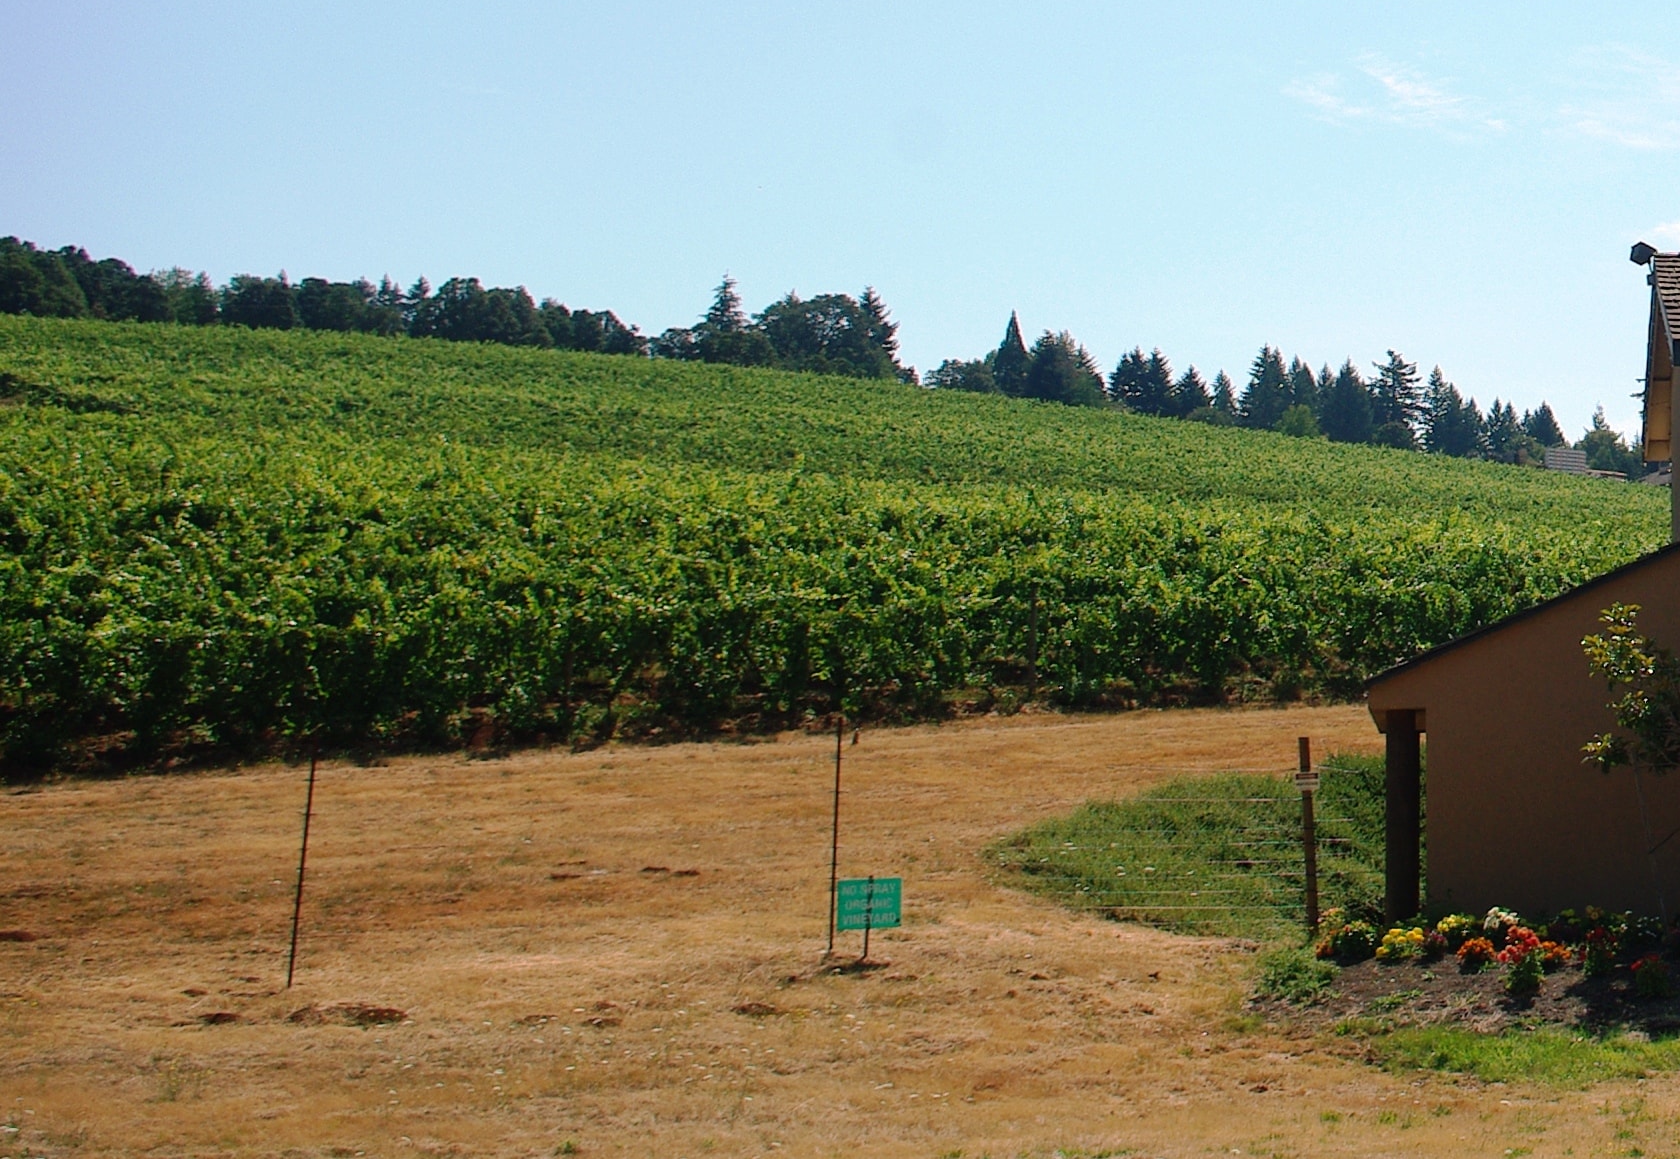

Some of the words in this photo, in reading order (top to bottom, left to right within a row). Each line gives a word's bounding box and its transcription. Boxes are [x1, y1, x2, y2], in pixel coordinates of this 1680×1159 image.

[841, 885, 856, 896] NO
[860, 883, 896, 895] SPRAY
[845, 897, 893, 910] ORGANIC
[842, 912, 896, 925] VINEYARD
